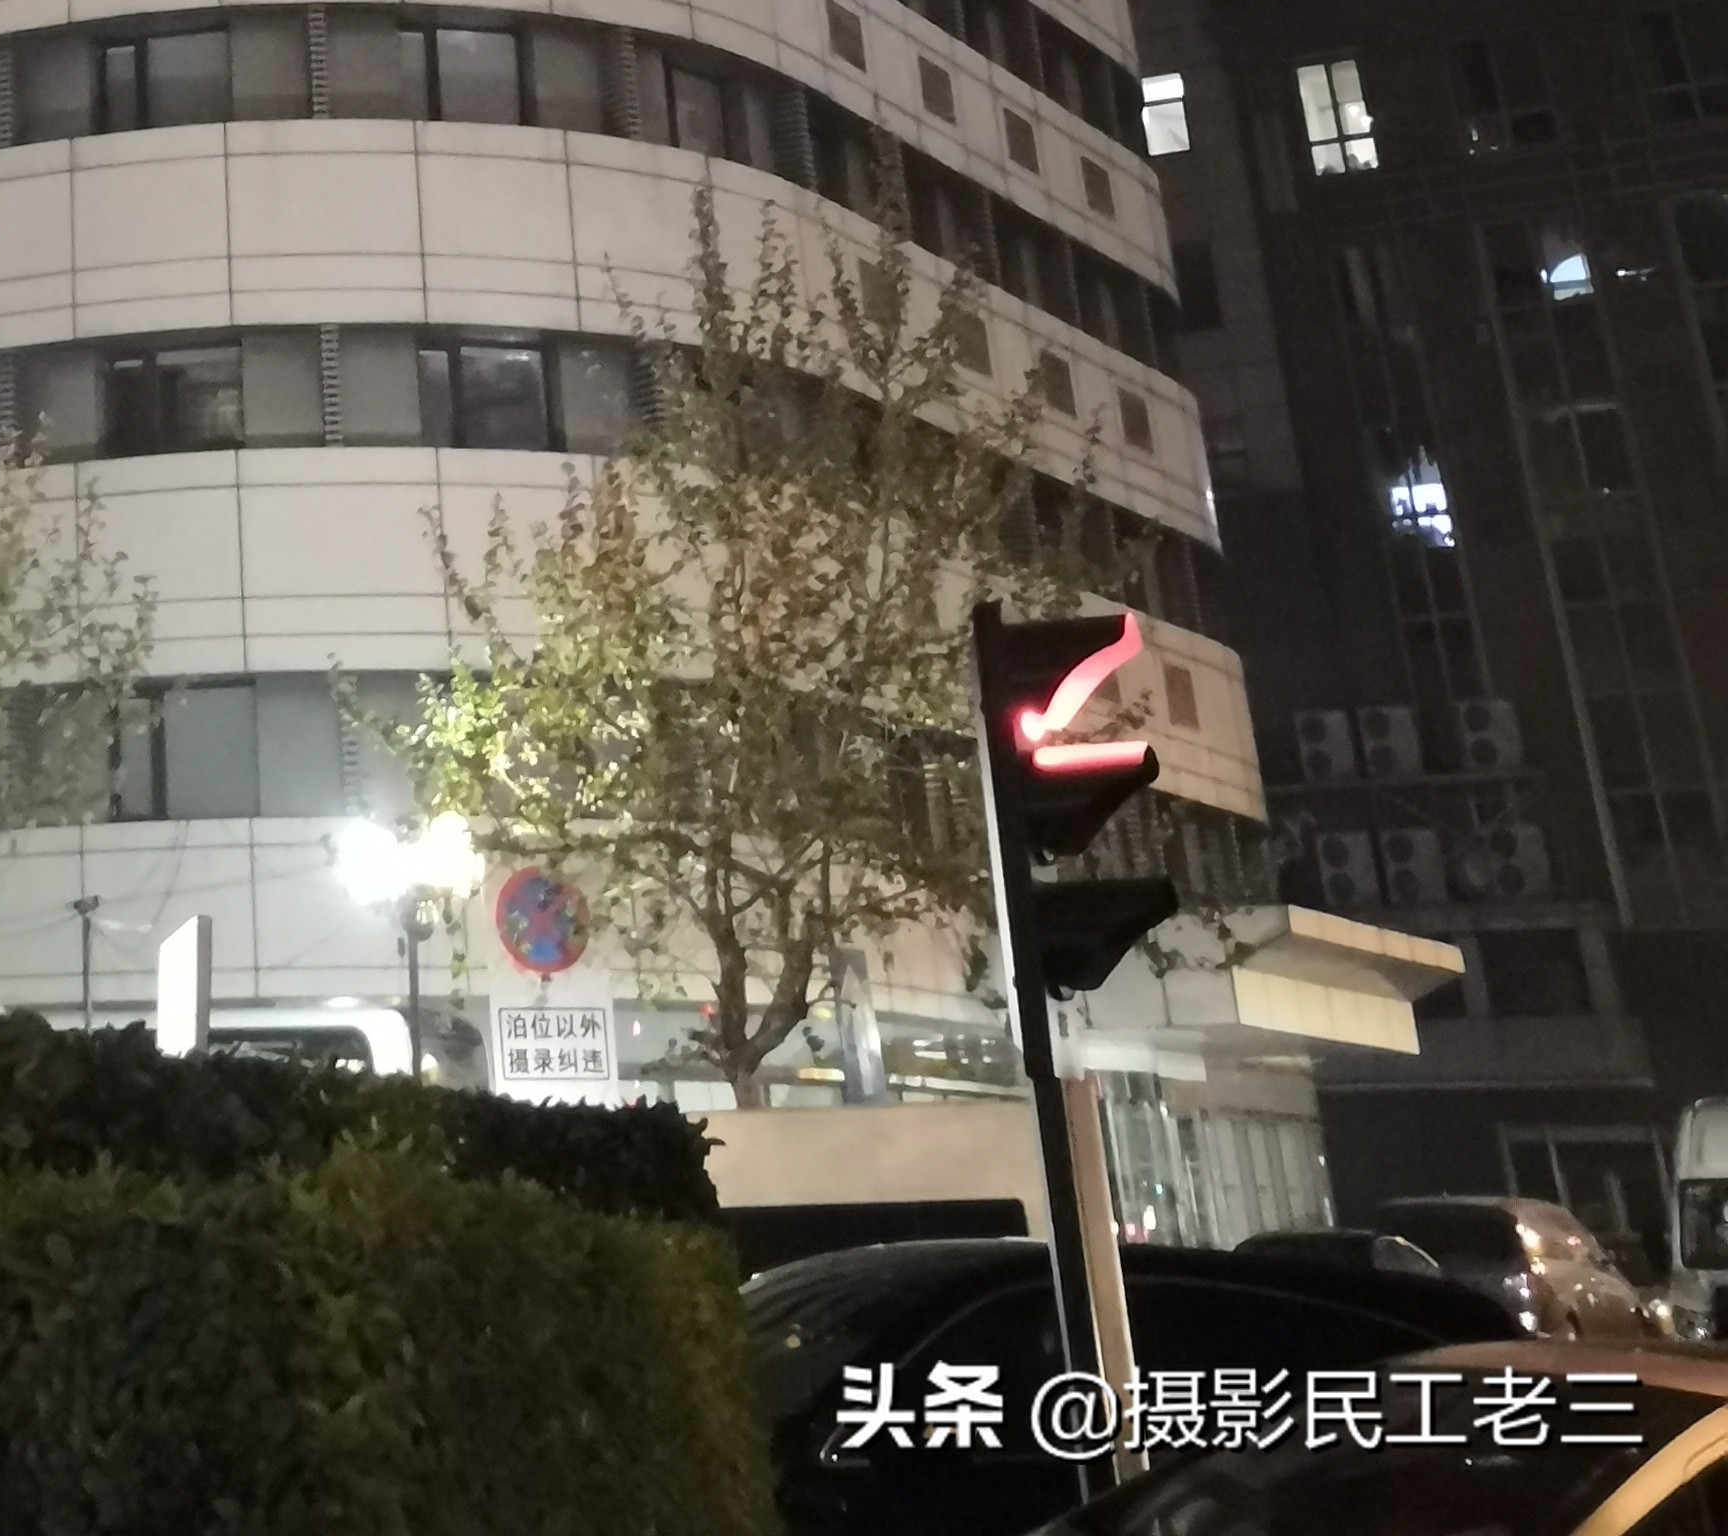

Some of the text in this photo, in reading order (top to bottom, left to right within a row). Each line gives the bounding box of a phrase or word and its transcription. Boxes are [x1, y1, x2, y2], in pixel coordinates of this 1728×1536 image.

[505, 1012, 602, 1040] 泊位以外
[507, 1047, 605, 1074] 摄录纠违
